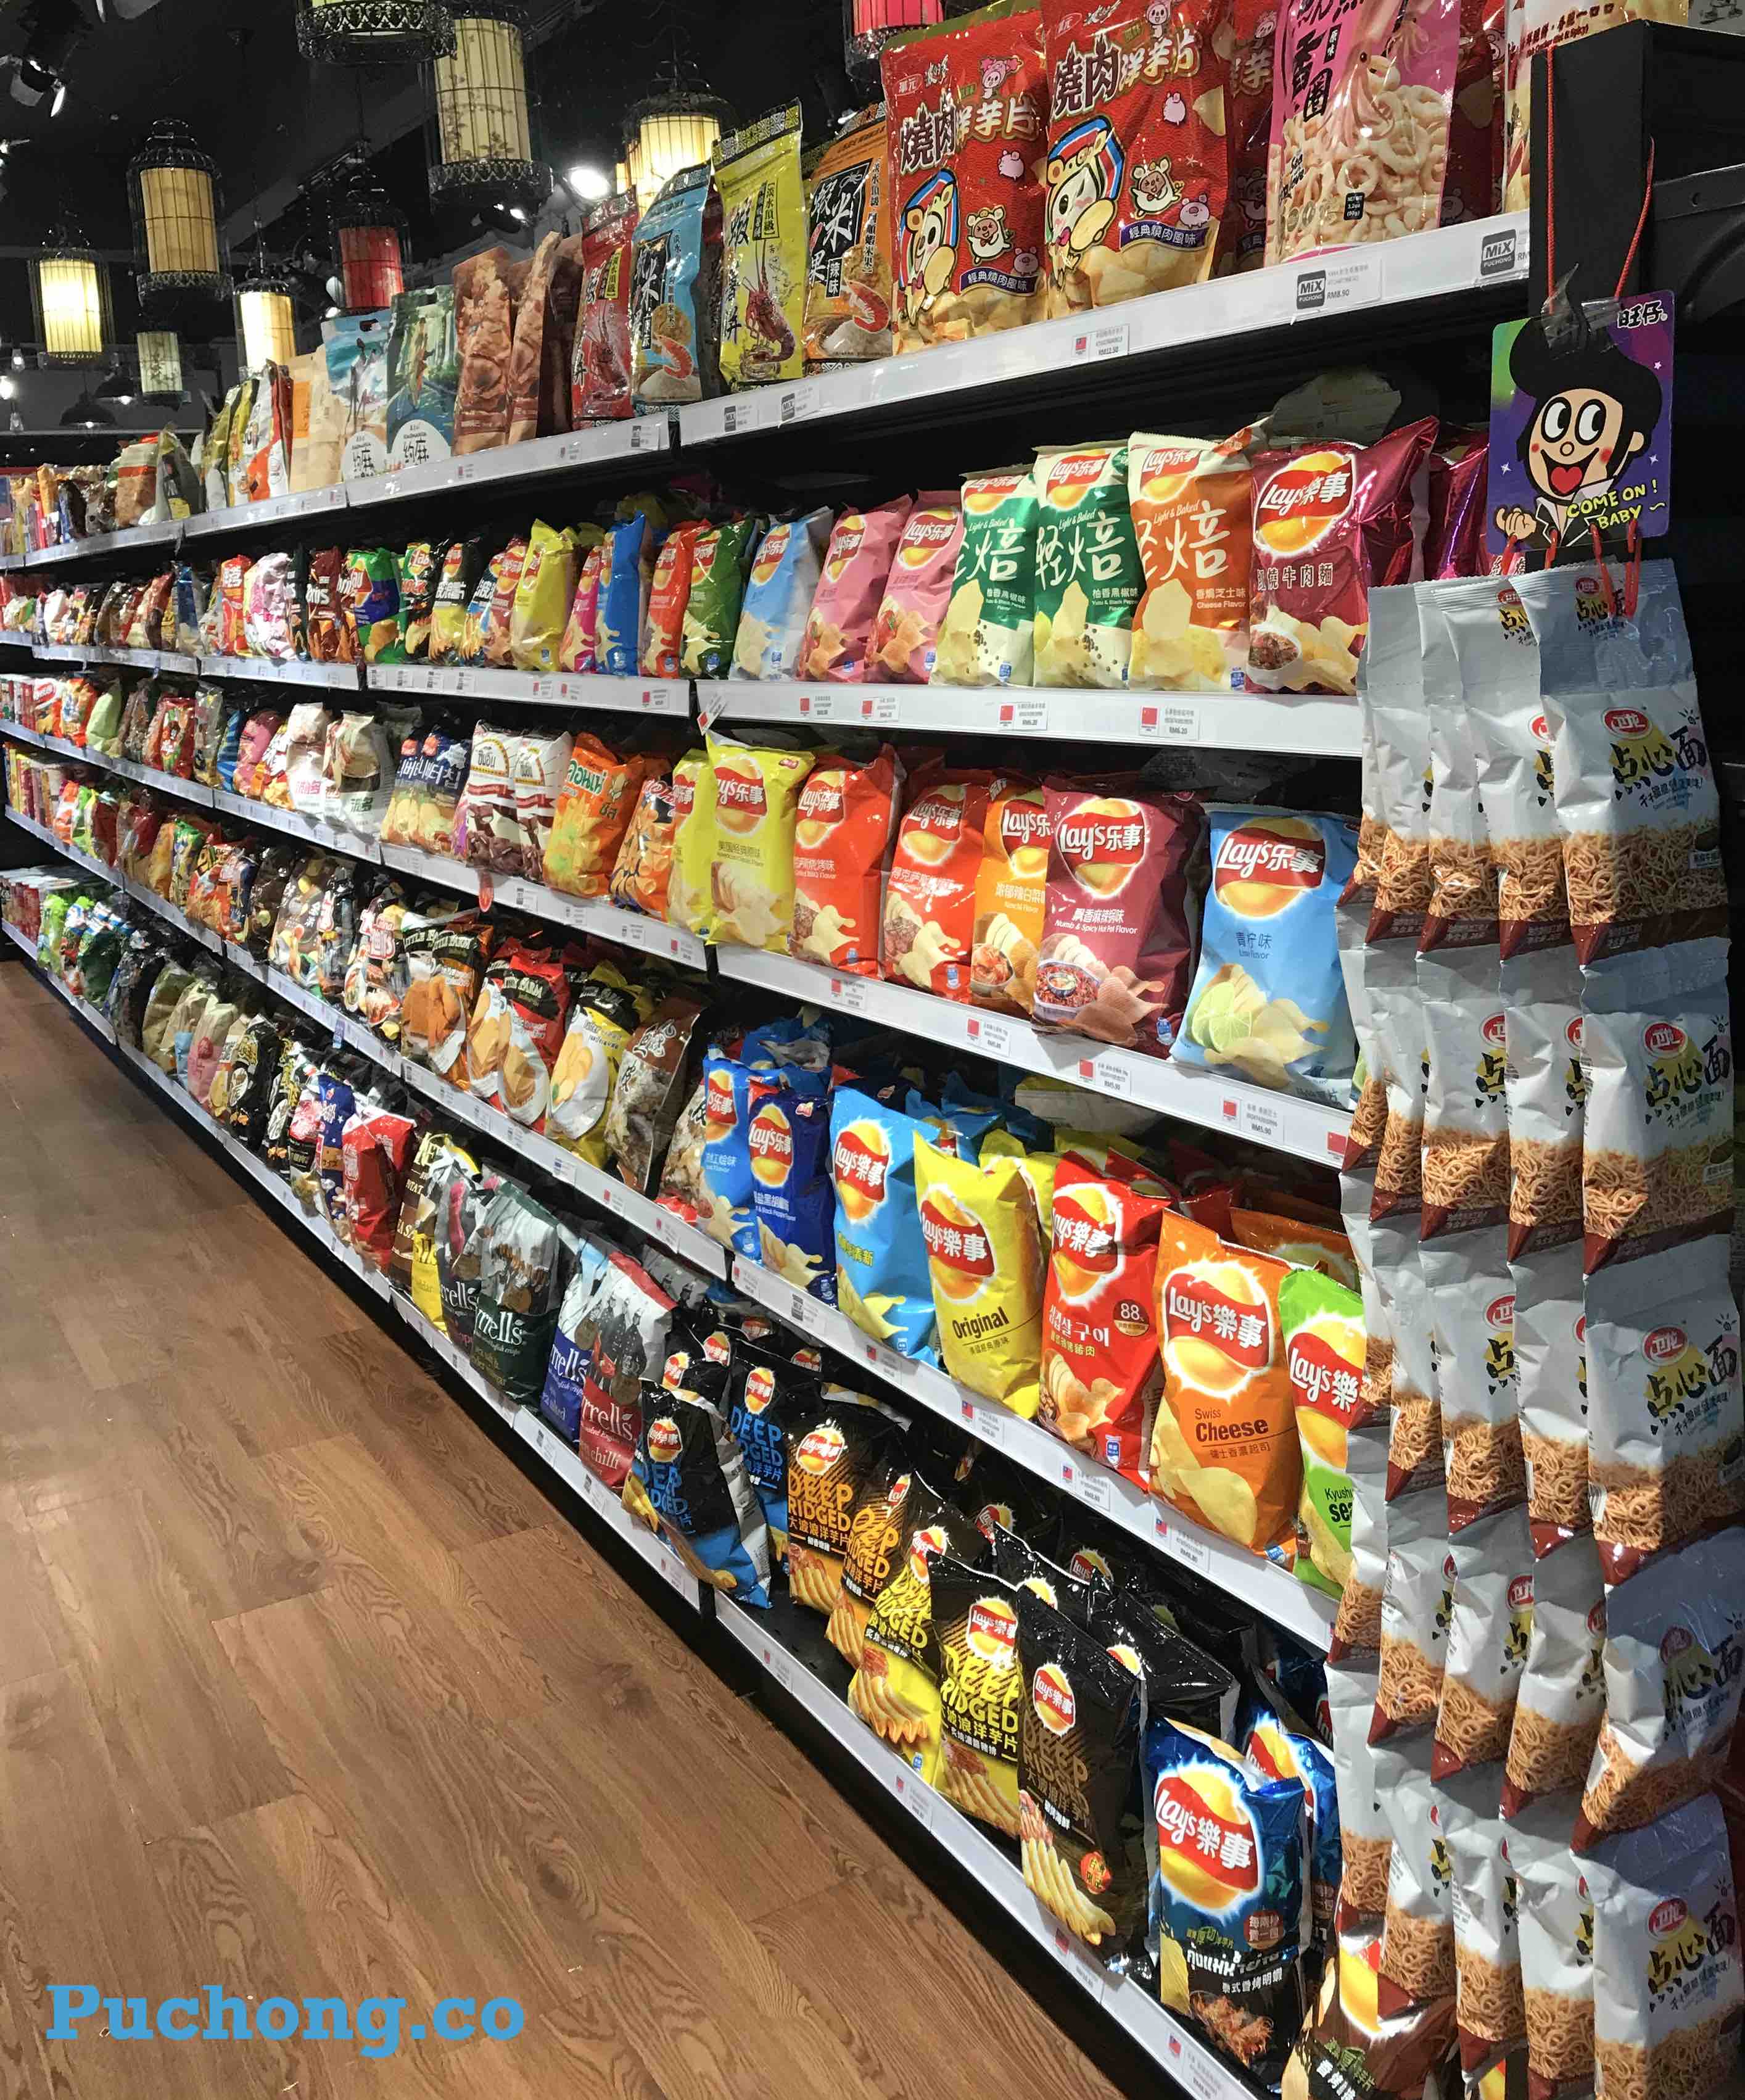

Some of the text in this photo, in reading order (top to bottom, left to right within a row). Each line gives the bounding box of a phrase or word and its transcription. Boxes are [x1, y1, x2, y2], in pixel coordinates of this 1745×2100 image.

[1050, 28, 1200, 122] 燒肉 洋芋片
[900, 86, 957, 175] 燒肉
[1129, 221, 1197, 246] 經典燒肉風味
[1483, 256, 1513, 268] PUCHONG
[1485, 239, 1513, 259] MiX
[827, 258, 842, 296] 辣味
[967, 271, 1028, 292] 經典燒肉風味
[1299, 279, 1324, 295] MiX
[1298, 288, 1351, 303] PUCHONG RM8.90
[1617, 300, 1664, 329] 旺仔
[1050, 460, 1079, 484] Lay's
[1142, 450, 1174, 474] Lay's
[1154, 510, 1169, 524] Light
[1176, 499, 1199, 516] Baked
[1260, 484, 1303, 516] Lay's
[1566, 490, 1619, 519] COME
[1622, 484, 1646, 502] ON
[968, 521, 983, 532] Light
[1058, 517, 1072, 531] Light
[1077, 508, 1097, 524] Baked
[1596, 504, 1642, 531] BABY
[1034, 511, 1126, 591] 轻焙
[1196, 599, 1247, 610] Cheese Flavor
[735, 783, 764, 804] 乐事
[934, 803, 962, 830] 乐事
[1002, 809, 1036, 844] Lay's
[1060, 822, 1145, 861] Lay's 乐事
[1217, 837, 1324, 878] Lay's 乐事
[1054, 919, 1075, 929] Numb
[1081, 924, 1098, 933] Spicy
[1115, 924, 1139, 935] Flavor
[1235, 931, 1273, 950] 青柠味
[712, 1093, 733, 1115] 乐事
[748, 1123, 793, 1155] Lay's 乐事
[836, 1141, 886, 1188] Lay's 樂事
[943, 1227, 988, 1262] 樂事
[1070, 1220, 1113, 1259] 樂事
[952, 1305, 1010, 1339] Original
[1120, 1302, 1141, 1321] 88
[1169, 1287, 1266, 1349] Lay's 樂事
[1073, 1321, 1109, 1347] 구이
[1289, 1347, 1360, 1413] Lay's 樂
[730, 1405, 783, 1448] DEEP
[1194, 1407, 1222, 1420] Swiss
[1195, 1418, 1269, 1442] Cheese
[788, 1467, 854, 1510] DEEP
[788, 1495, 851, 1533] RIDGED
[972, 1608, 1017, 1639] Lay's 樂事
[940, 1677, 1019, 1735] RIDGED
[1035, 1674, 1073, 1717] Lay's 樂事
[1156, 1789, 1254, 1871] Lay's 樂事
